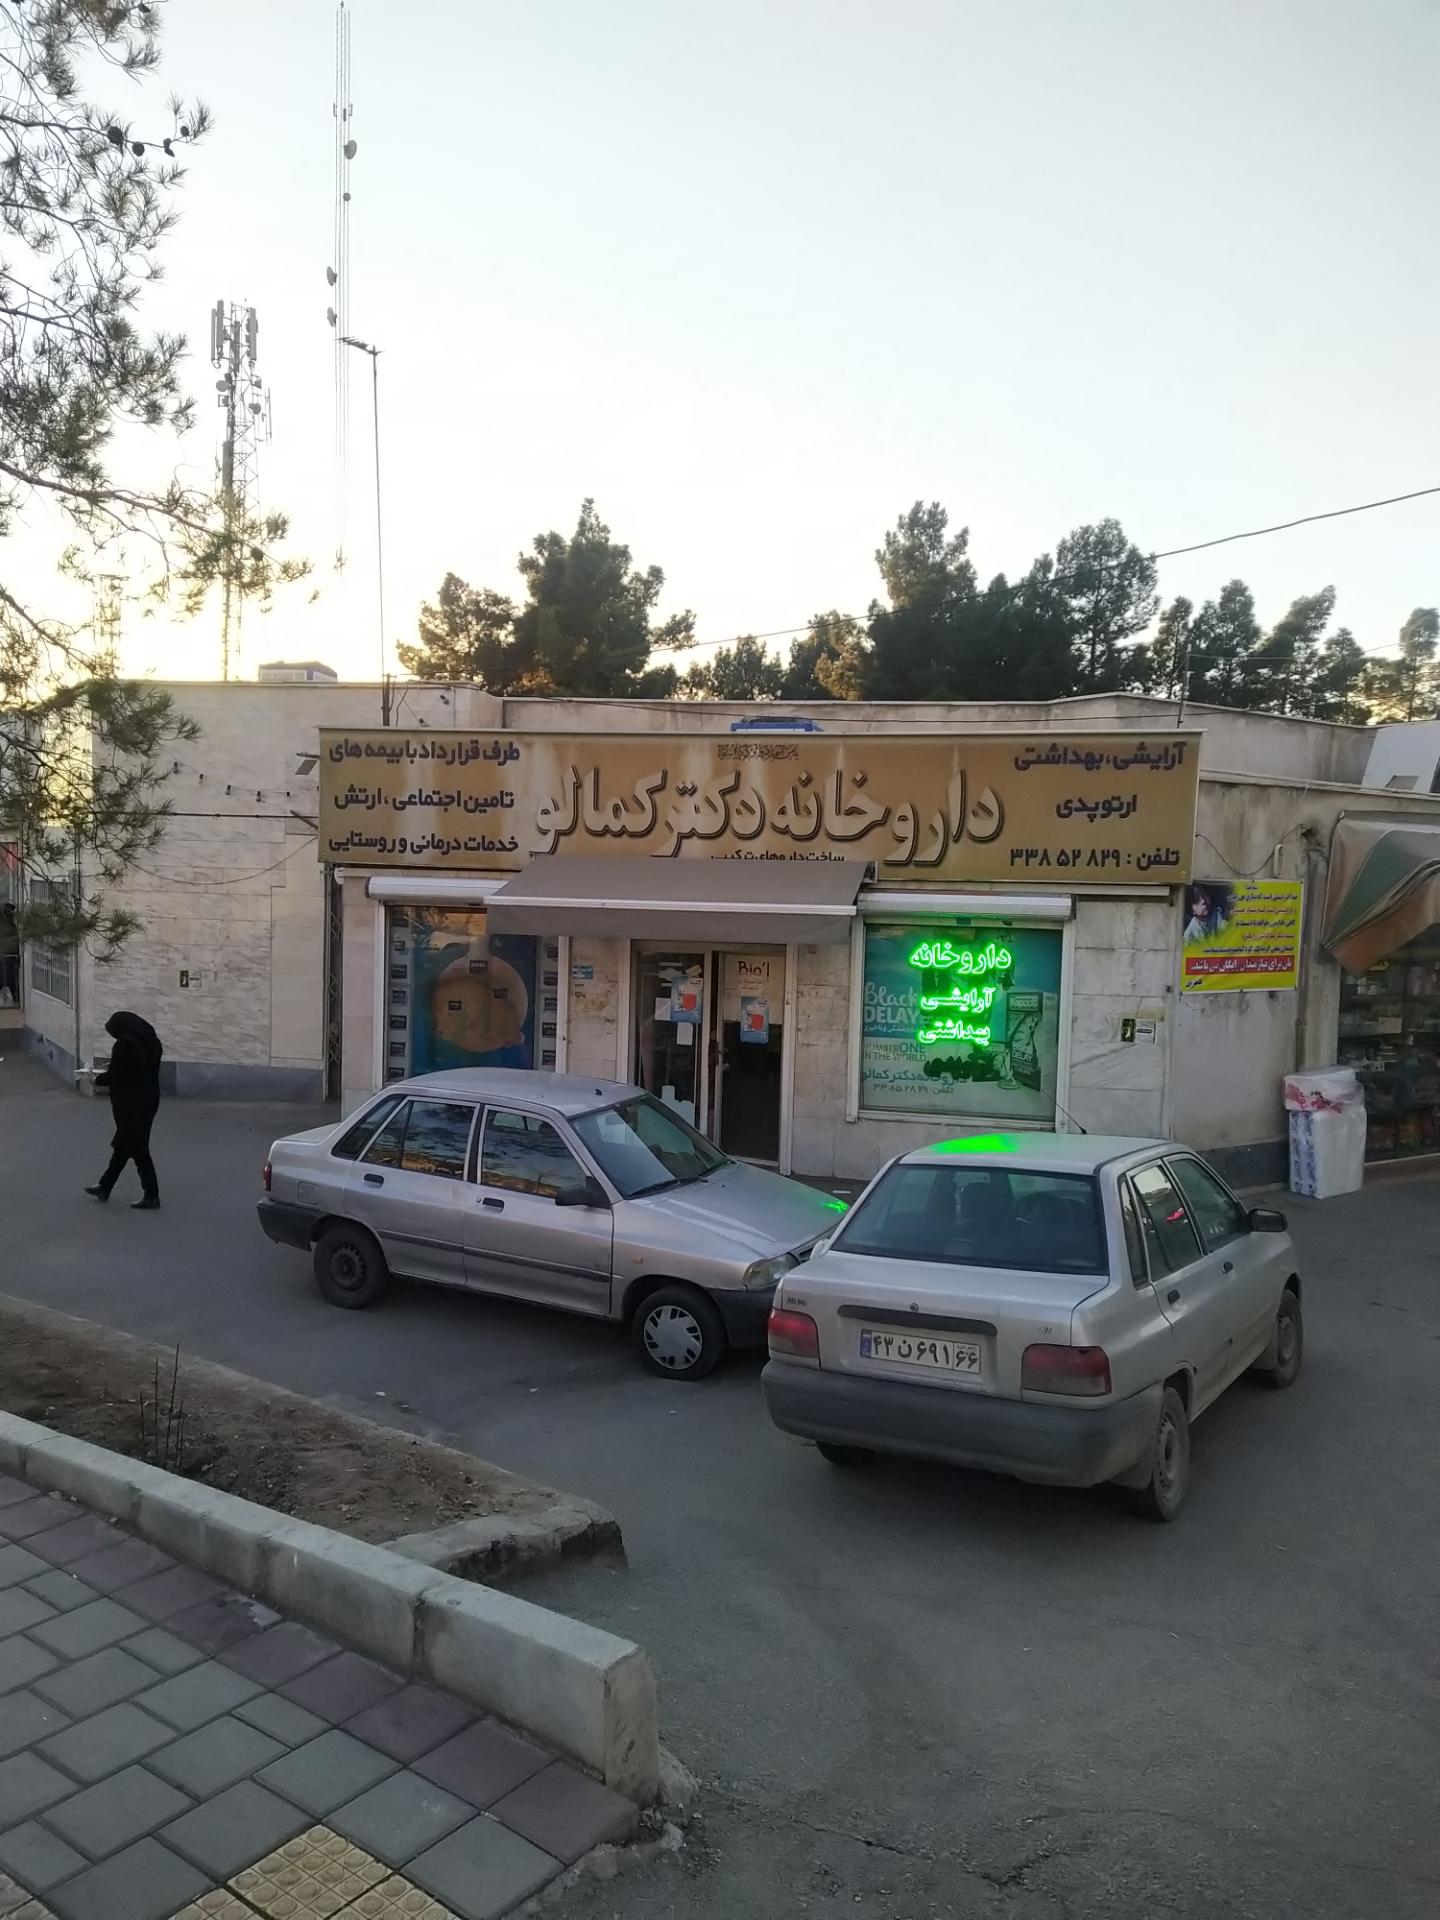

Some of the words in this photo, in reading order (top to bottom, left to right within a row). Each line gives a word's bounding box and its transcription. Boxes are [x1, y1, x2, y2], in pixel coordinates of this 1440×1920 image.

[329, 738, 363, 763] های
[365, 741, 405, 764] بیمه
[404, 739, 418, 765] با
[419, 739, 480, 766] قرارداد
[482, 740, 520, 767] طرف
[333, 783, 382, 811] ارتش
[463, 789, 515, 814] تامین
[1055, 794, 1138, 824] ارتوپدی
[650, 764, 766, 857] دکتر
[769, 766, 1005, 867] داروخانه
[328, 830, 397, 854] روستایی
[397, 836, 408, 855] و
[410, 832, 462, 856] درمانی
[463, 834, 520, 854] خدمات
[909, 941, 1012, 974] داروخانه
[863, 981, 919, 1007] Black
[920, 985, 996, 1014] آرایشی
[863, 1005, 920, 1025] DELAY
[918, 1018, 991, 1046] بهداشتی
[899, 1042, 927, 1053] ONE
[916, 1340, 950, 1365] ۶۹۱
